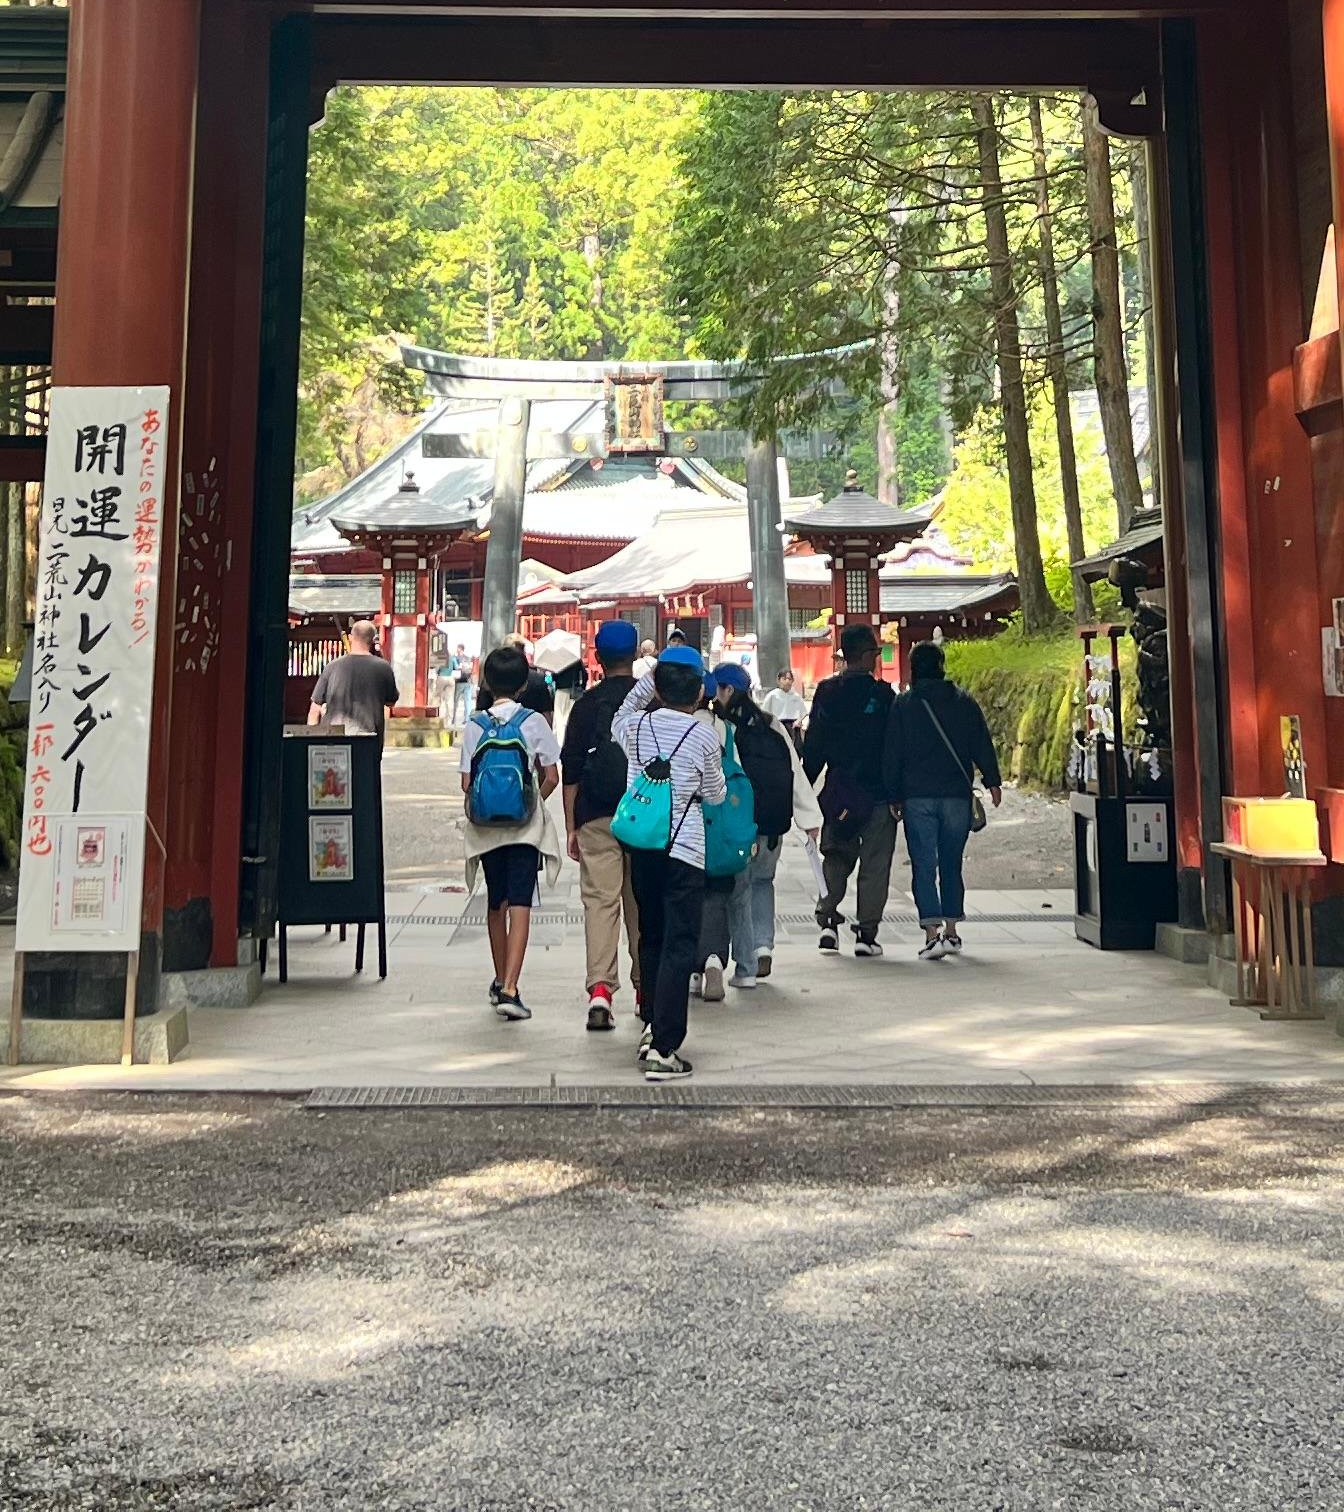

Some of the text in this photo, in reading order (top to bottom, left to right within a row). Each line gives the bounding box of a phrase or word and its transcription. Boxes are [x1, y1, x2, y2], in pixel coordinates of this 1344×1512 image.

[61, 423, 129, 813] 開運カレンダー
